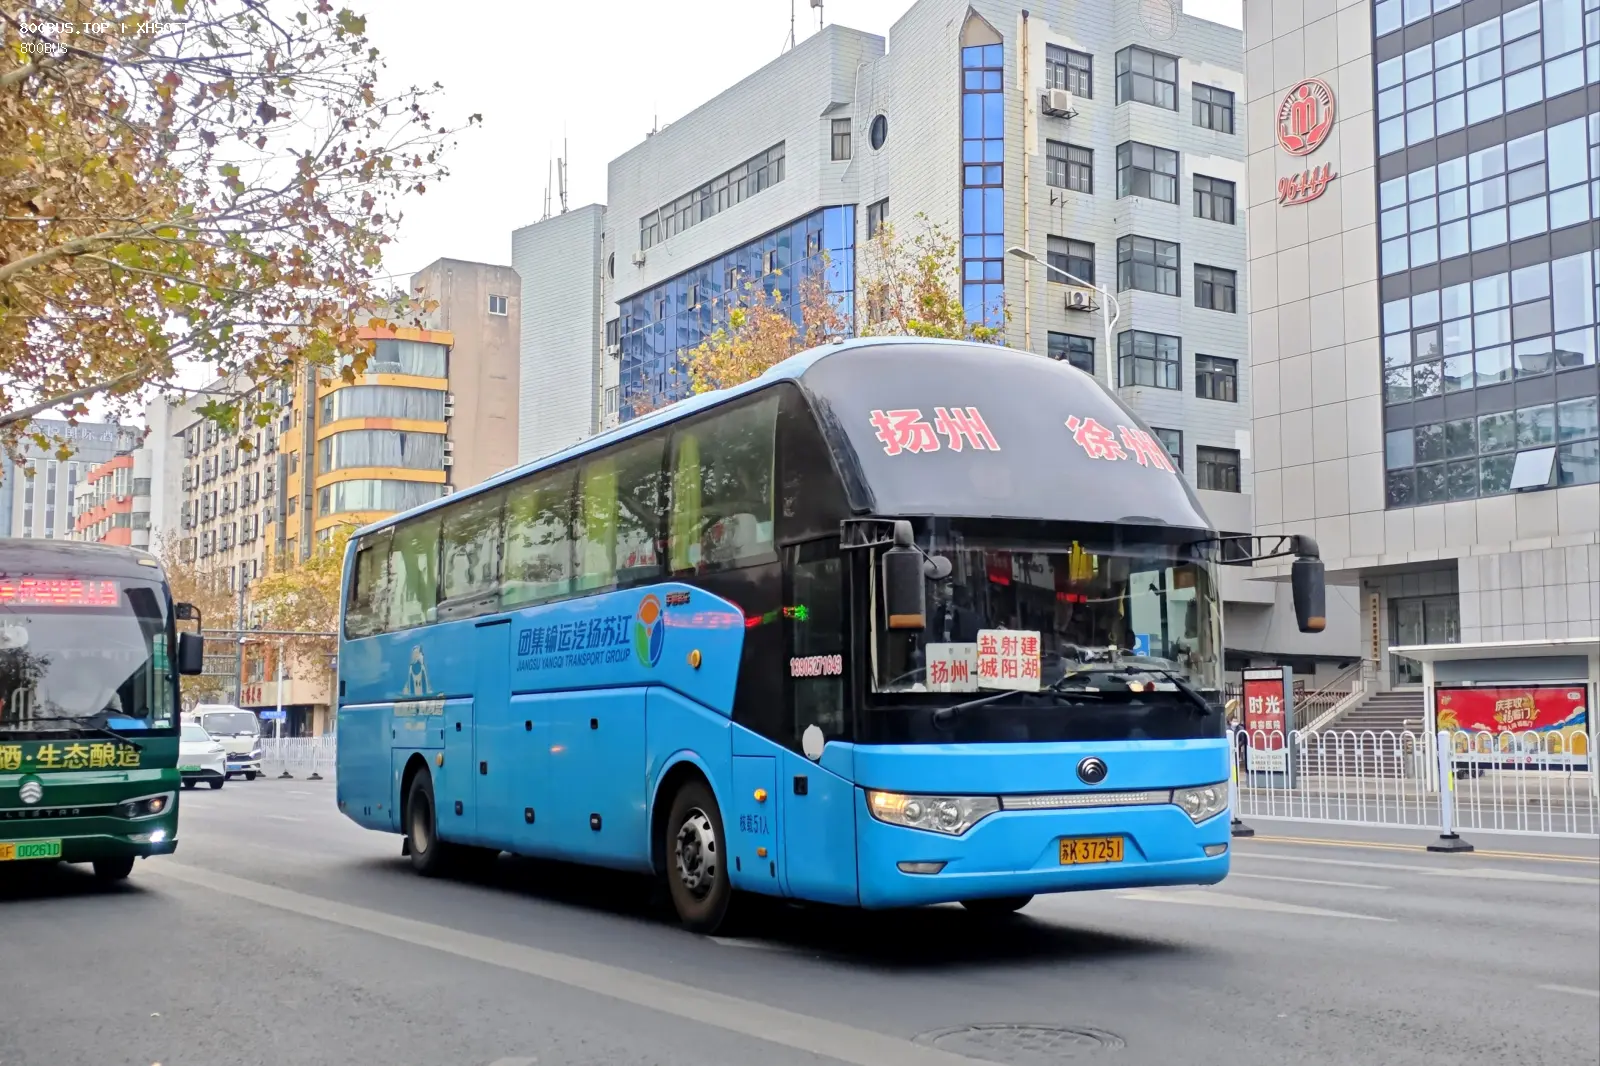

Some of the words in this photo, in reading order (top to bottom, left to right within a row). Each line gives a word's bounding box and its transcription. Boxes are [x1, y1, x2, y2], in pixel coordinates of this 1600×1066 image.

[1278, 161, 1337, 206] 96444
[869, 406, 1001, 456] 扬州
[1064, 414, 1176, 474] 徐州
[516, 656, 540, 672] JIANGSU
[541, 655, 565, 670] YANGQI
[565, 650, 605, 667] TRANSPORT
[605, 648, 631, 664] GROUP
[930, 659, 969, 684] 扬州
[1248, 695, 1280, 715] 时光
